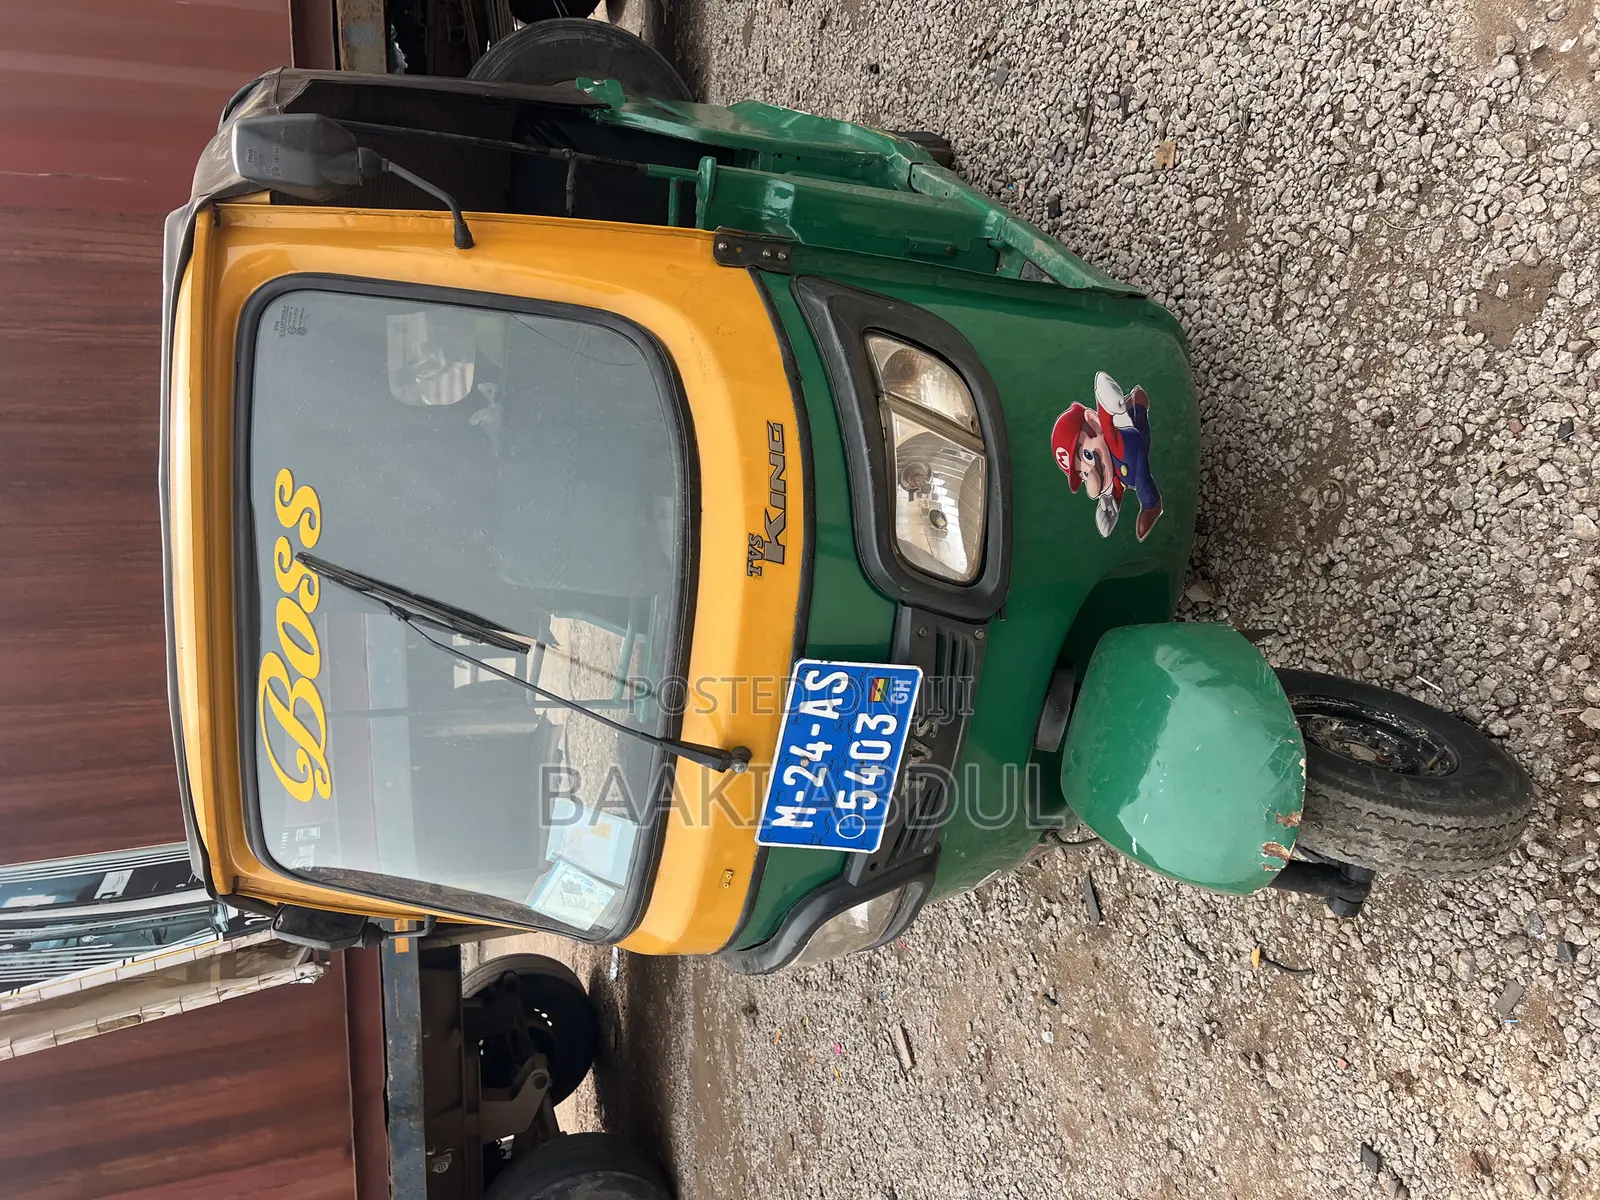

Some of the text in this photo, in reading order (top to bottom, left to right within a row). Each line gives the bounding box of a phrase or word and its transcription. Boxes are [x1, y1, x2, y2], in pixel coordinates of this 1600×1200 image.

[762, 420, 787, 565] KING
[746, 533, 764, 577] TVS
[258, 467, 332, 802] Boss
[890, 679, 912, 705] GH
[770, 669, 850, 829] M-24-AS
[834, 711, 899, 811] 5403
[900, 714, 939, 797] TVS
